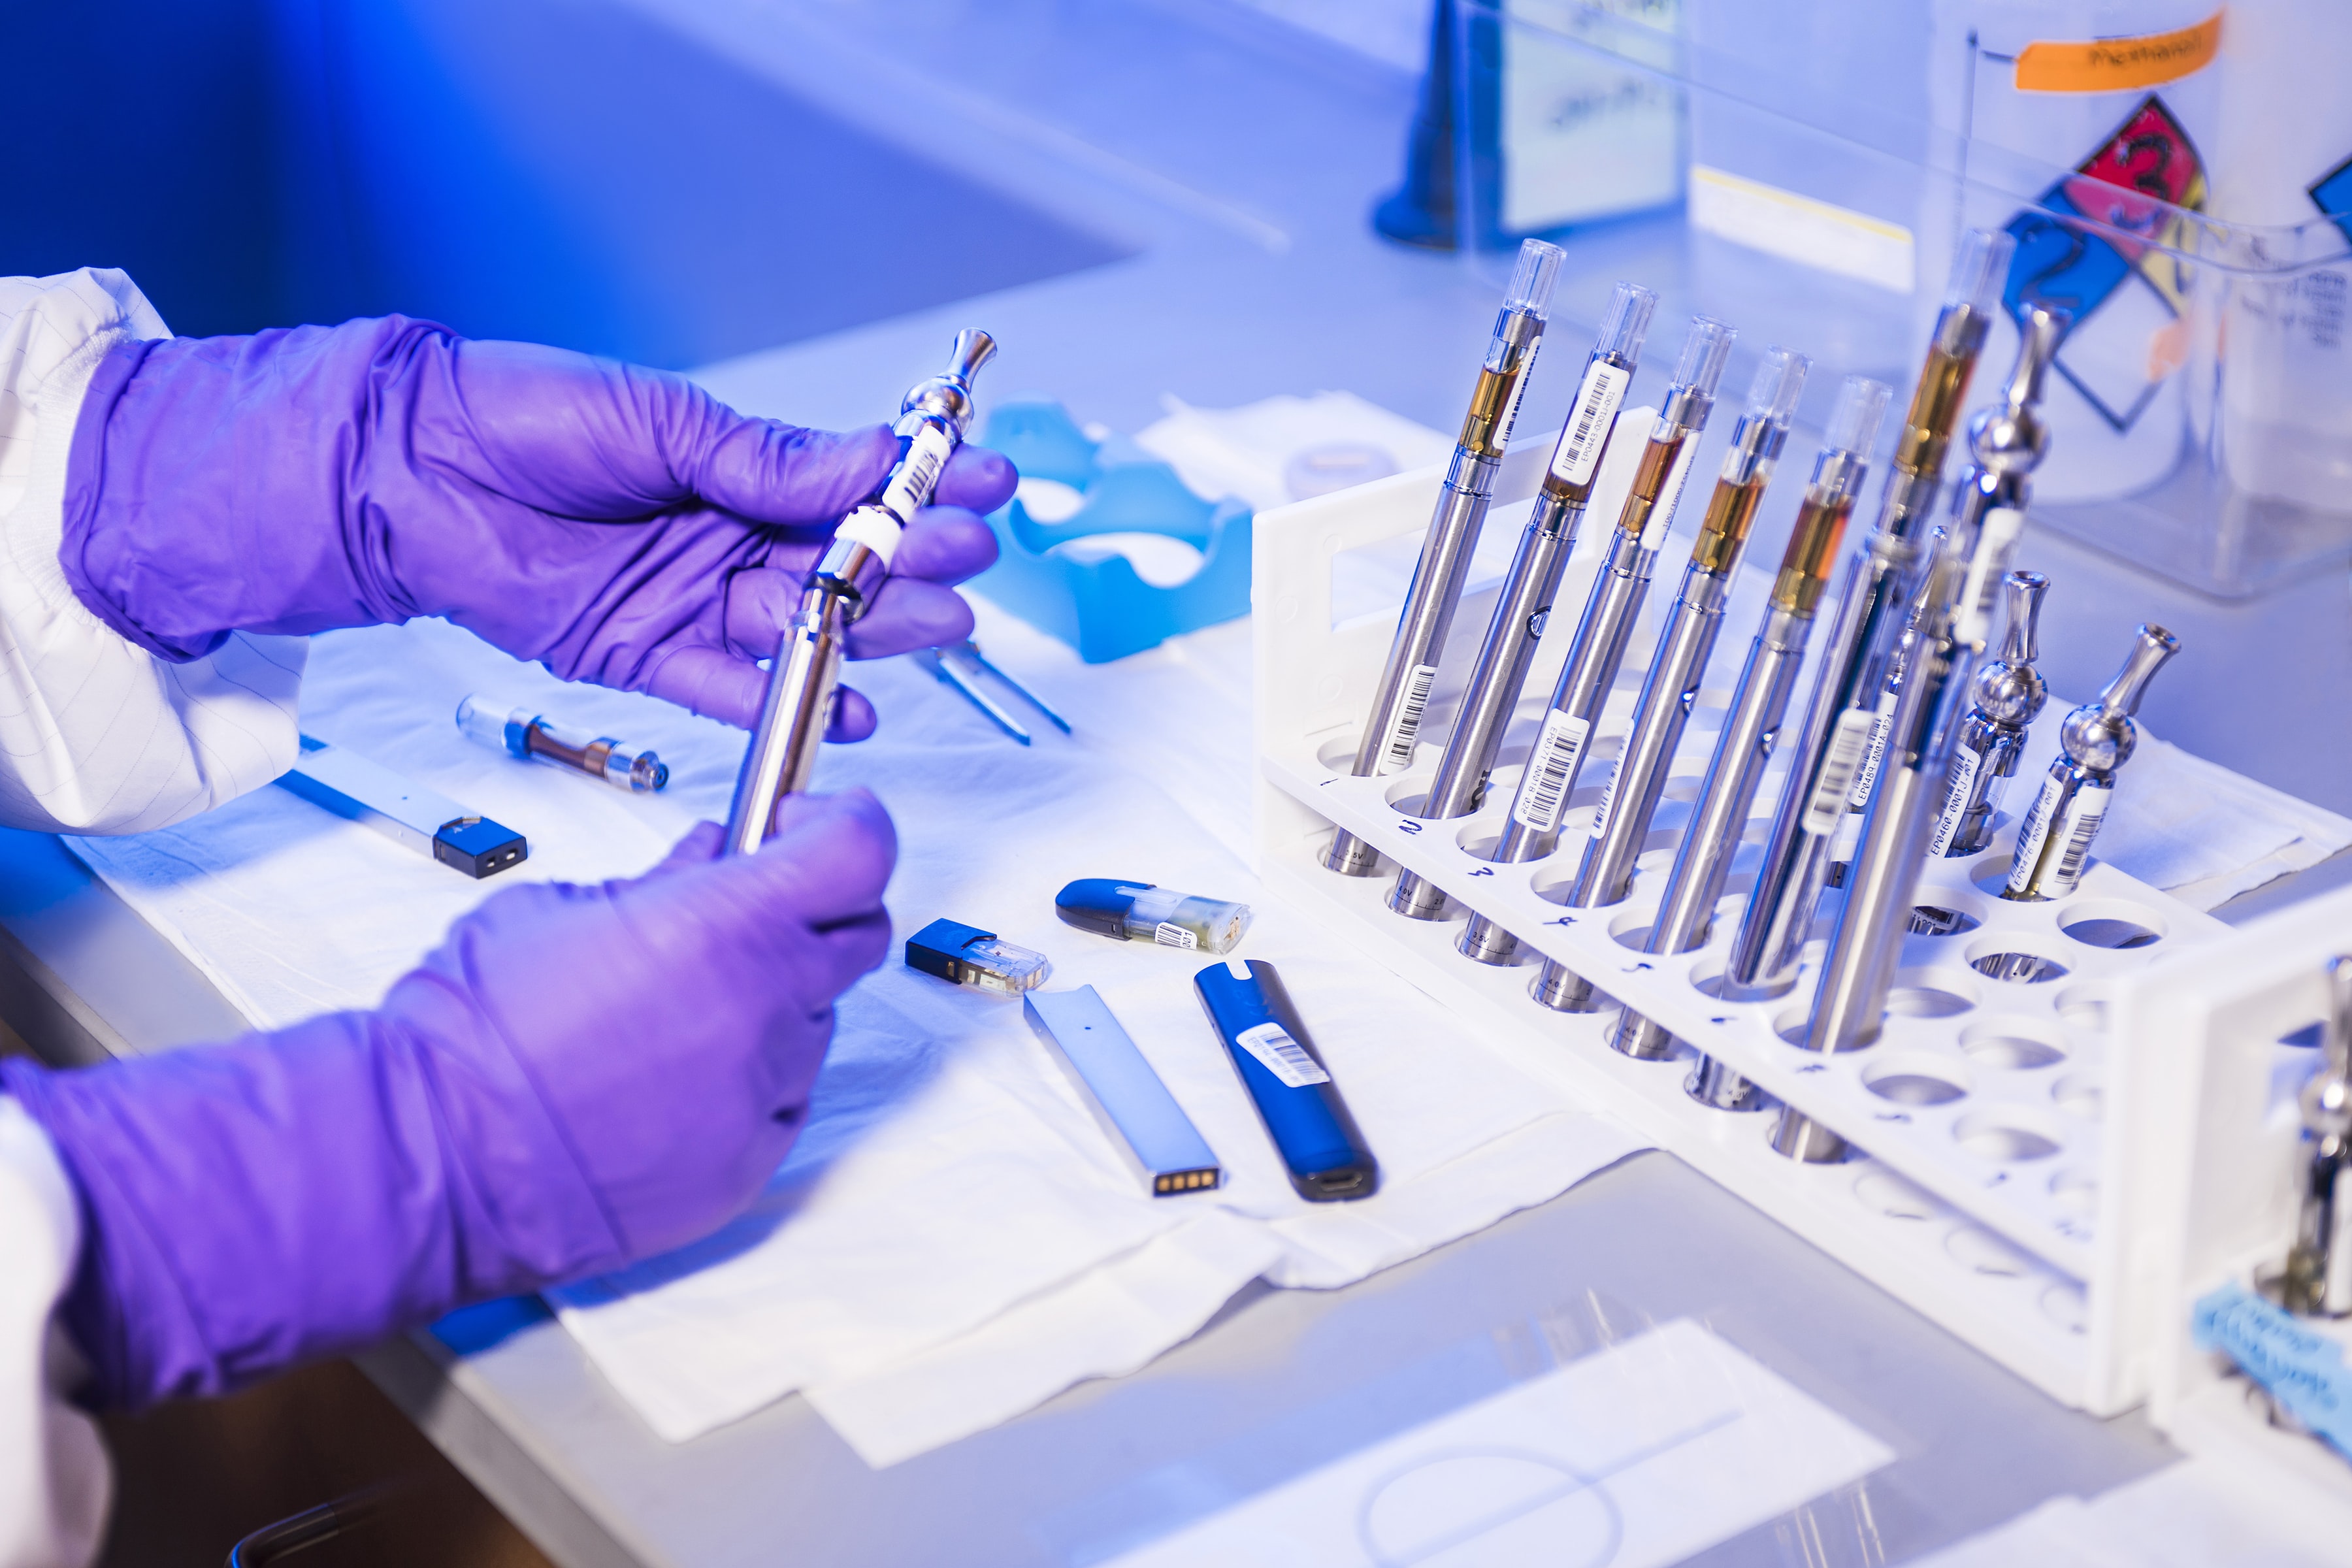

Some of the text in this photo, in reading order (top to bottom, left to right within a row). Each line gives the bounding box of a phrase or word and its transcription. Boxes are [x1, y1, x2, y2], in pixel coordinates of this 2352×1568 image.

[2017, 220, 2084, 308] 2
[1521, 727, 1558, 814] EP0371-0001B-028
[1858, 713, 1894, 800] EP0489-0001A-024
[1398, 819, 1423, 836] 2
[1931, 758, 1974, 855] EP0460-0001J-001
